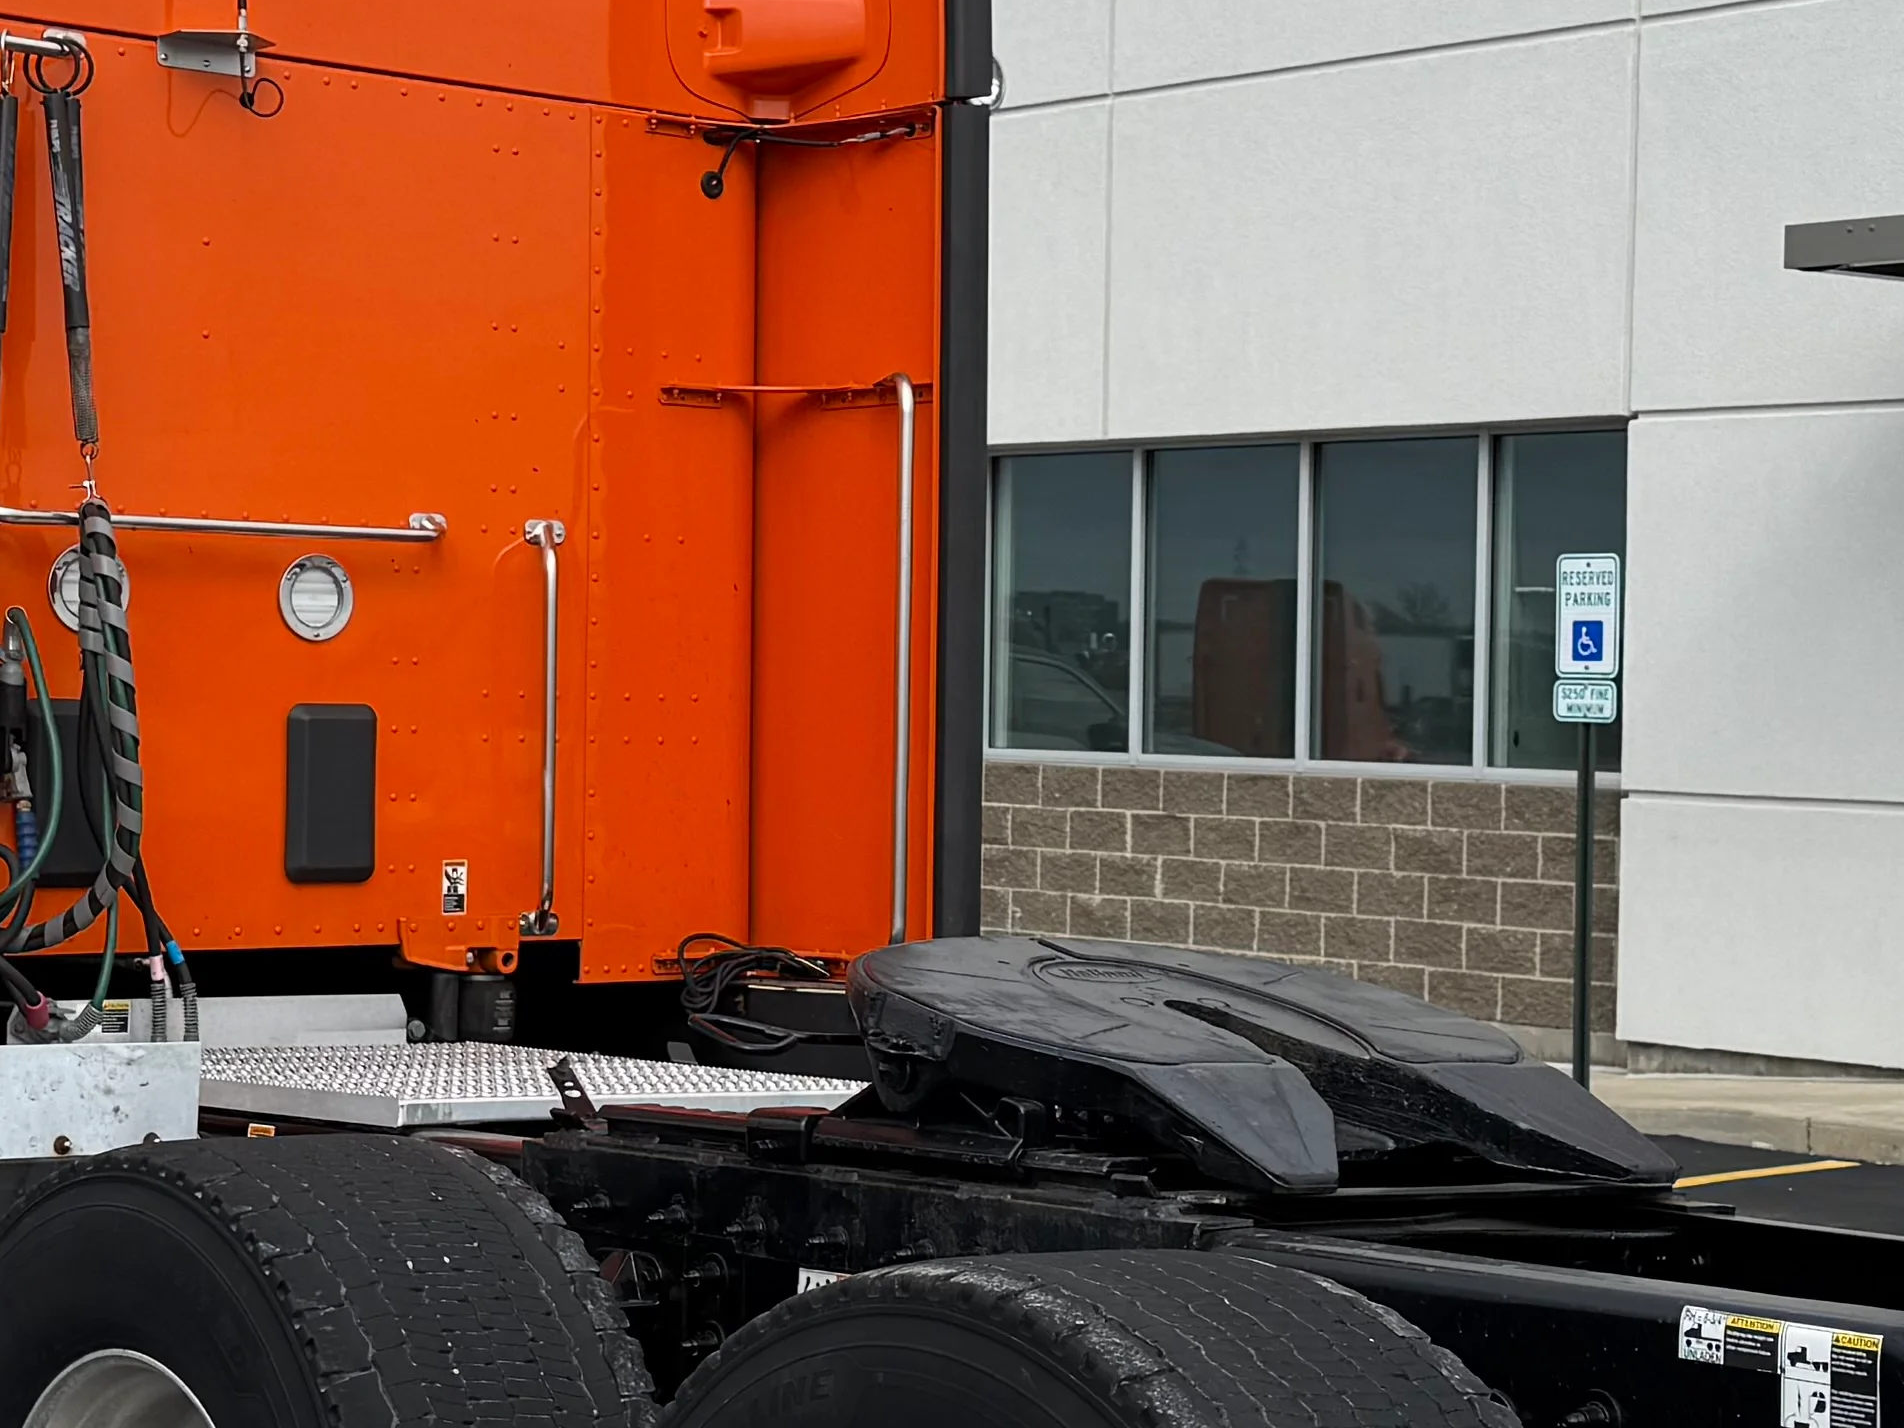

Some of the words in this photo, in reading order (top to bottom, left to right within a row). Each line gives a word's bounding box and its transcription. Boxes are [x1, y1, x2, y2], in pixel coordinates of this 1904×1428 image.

[1561, 571, 1614, 586] RESERVED
[1564, 592, 1611, 607] PARKING
[1590, 688, 1610, 700] FINE
[1565, 703, 1604, 715] MINIMUM
[1730, 1317, 1775, 1331] ATTENTION
[1840, 1336, 1880, 1349] CAUTION
